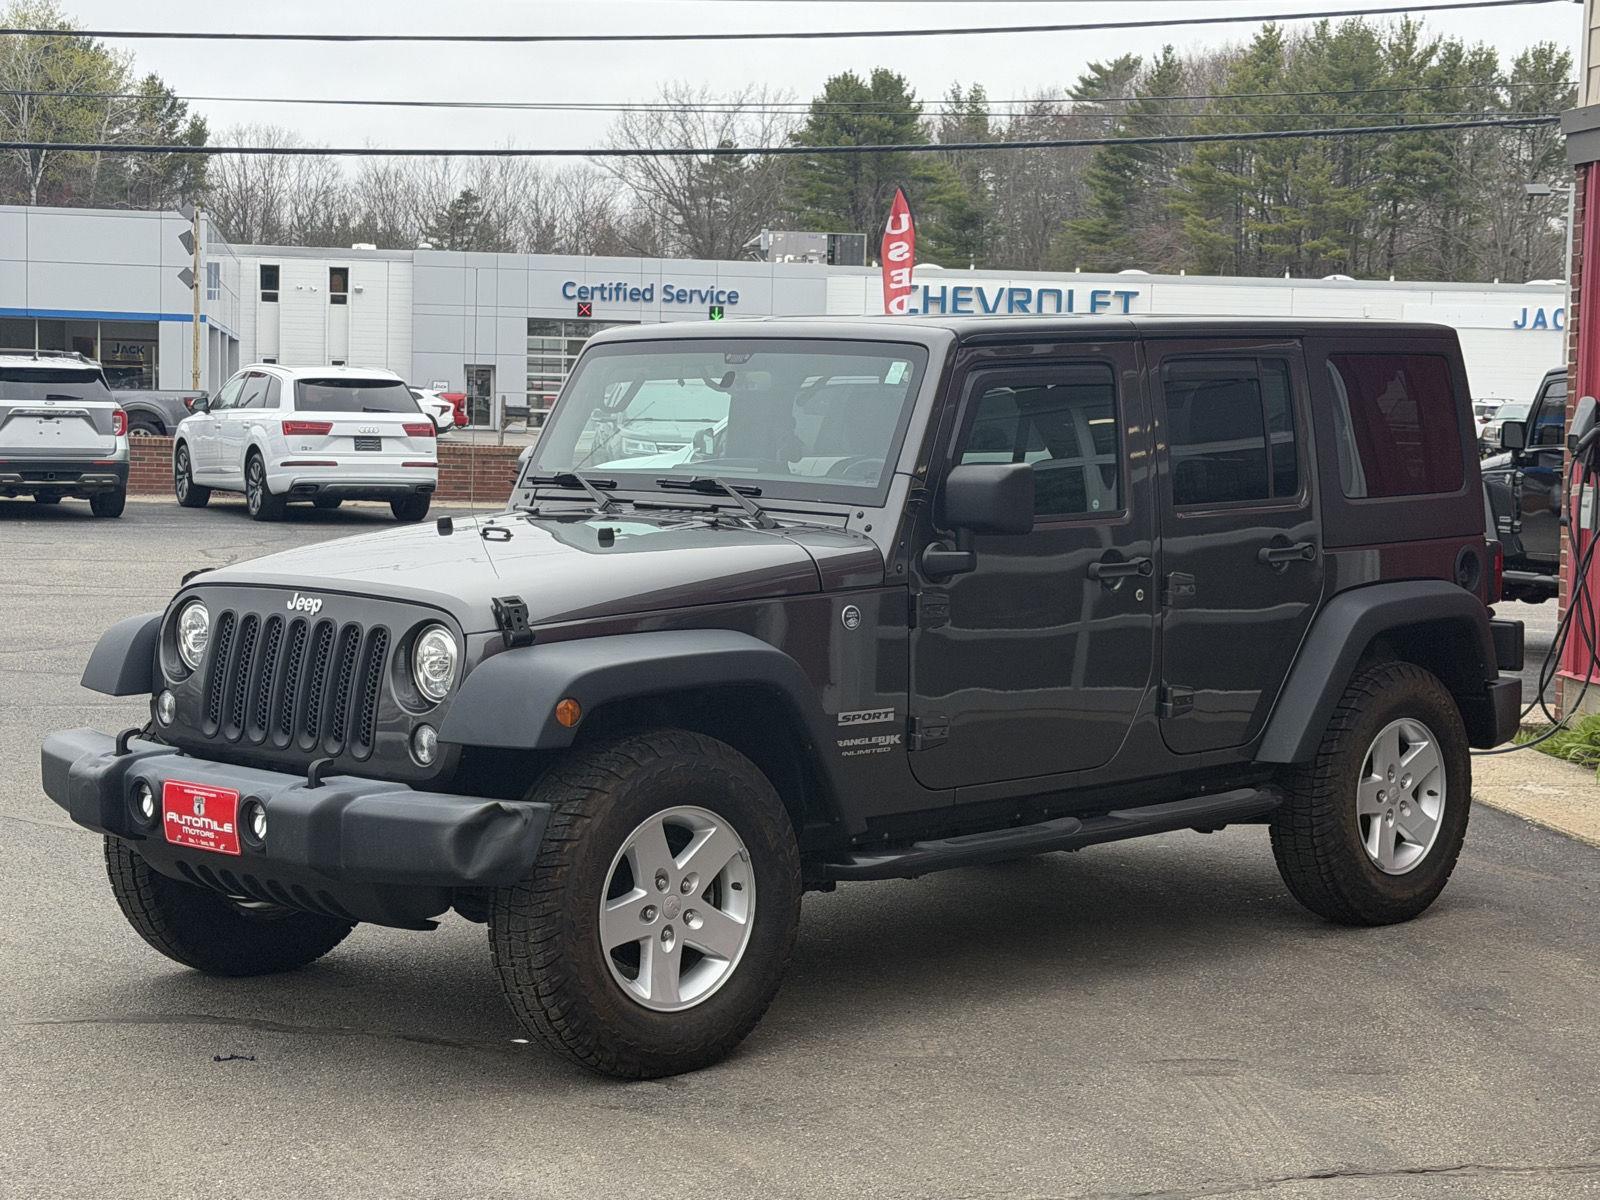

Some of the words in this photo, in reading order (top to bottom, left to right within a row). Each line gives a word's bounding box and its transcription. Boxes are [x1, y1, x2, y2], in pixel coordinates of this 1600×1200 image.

[562, 281, 655, 302] Certified
[662, 284, 740, 304] Service
[111, 343, 144, 354] JACK
[287, 592, 322, 616] Jeep
[840, 711, 893, 722] SPORT
[166, 812, 233, 833] AUTOMILE
[182, 826, 215, 838] MOTORS
